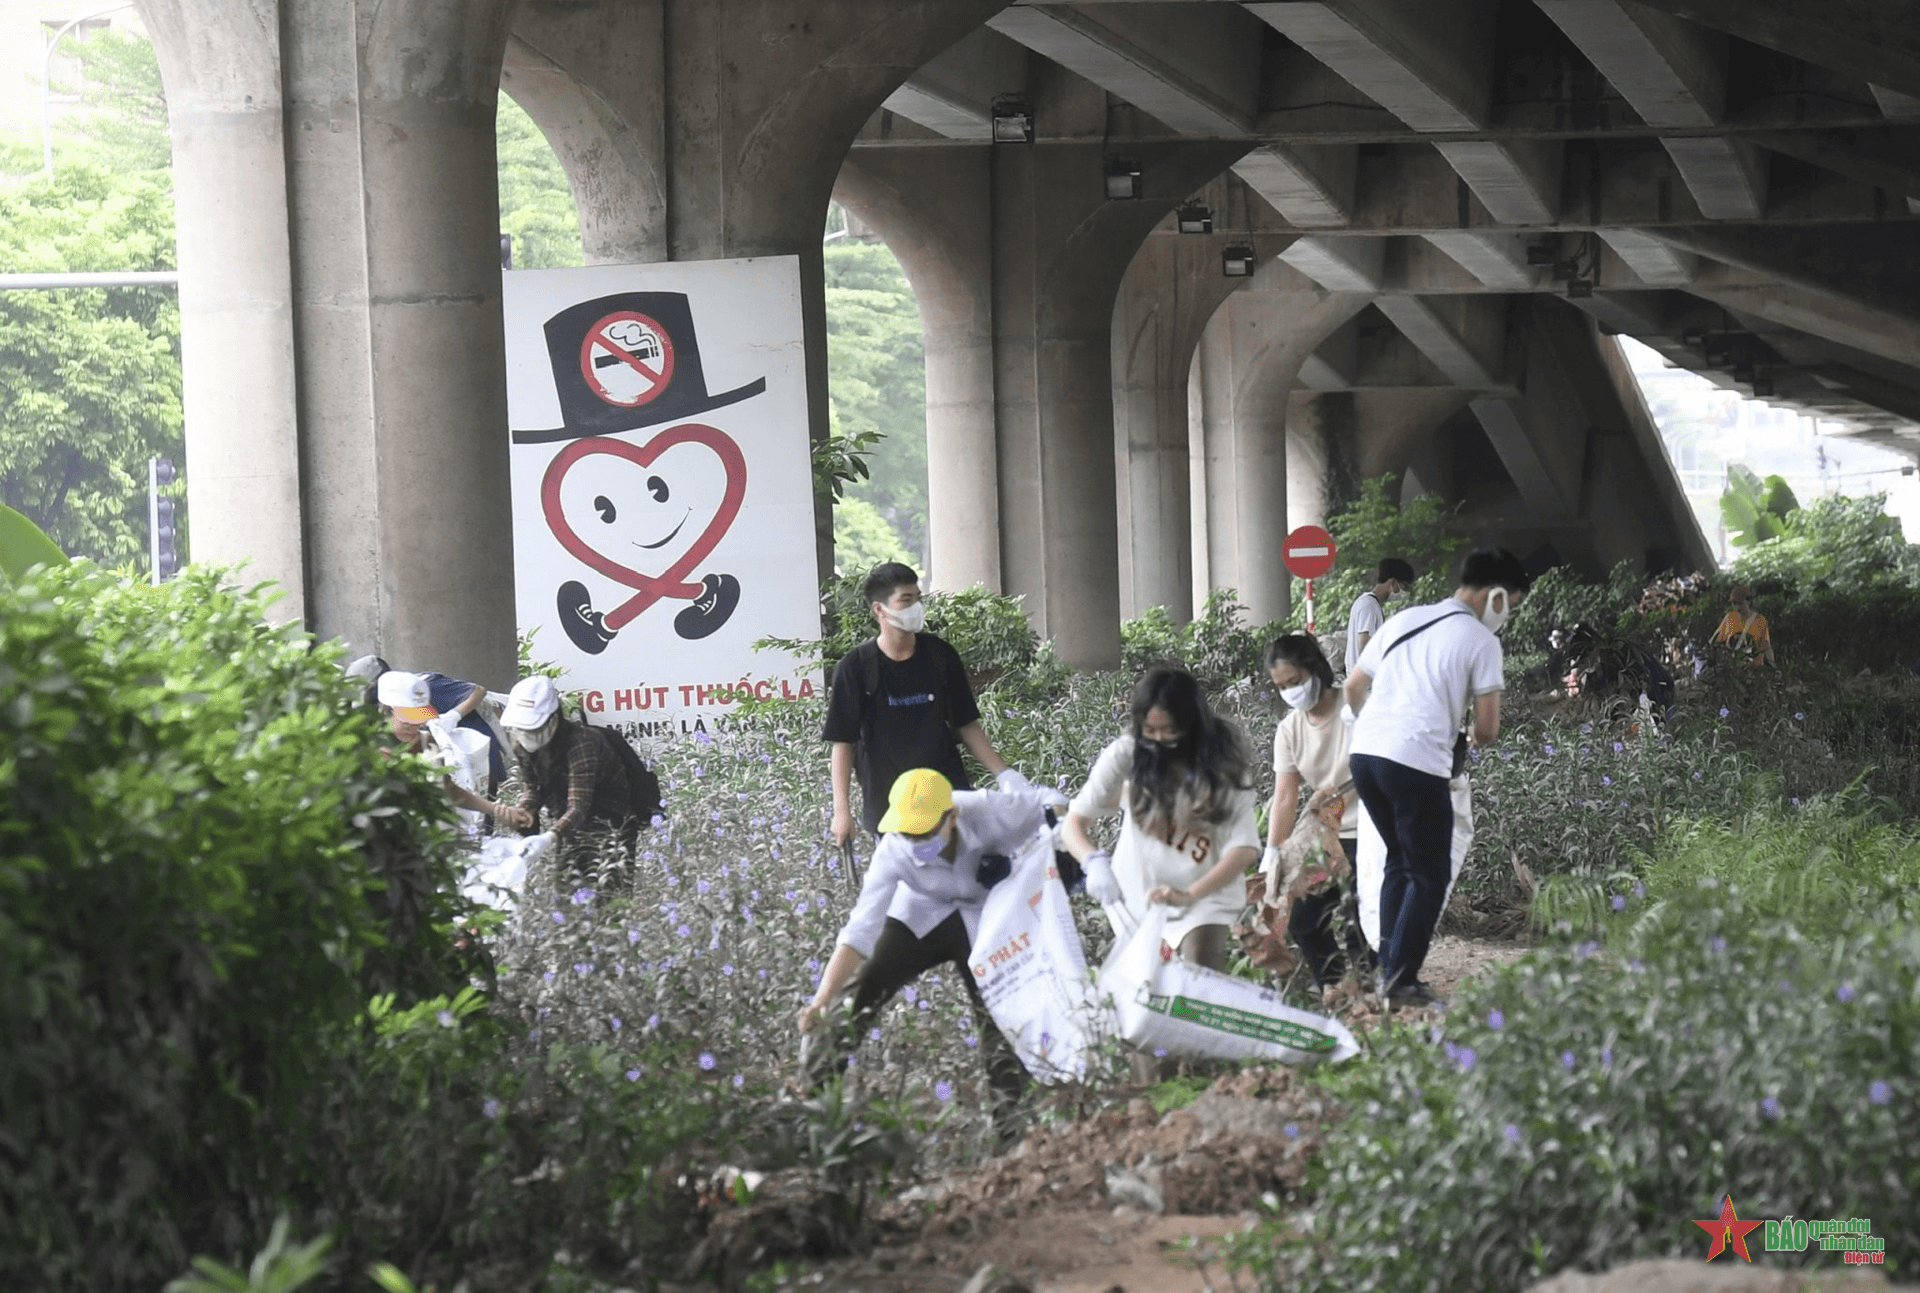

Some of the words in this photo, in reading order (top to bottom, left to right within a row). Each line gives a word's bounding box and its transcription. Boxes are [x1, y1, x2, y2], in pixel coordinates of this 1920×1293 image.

[614, 681, 669, 711] HÚT
[678, 671, 773, 706] THUỐC
[681, 713, 707, 736] LÀ
